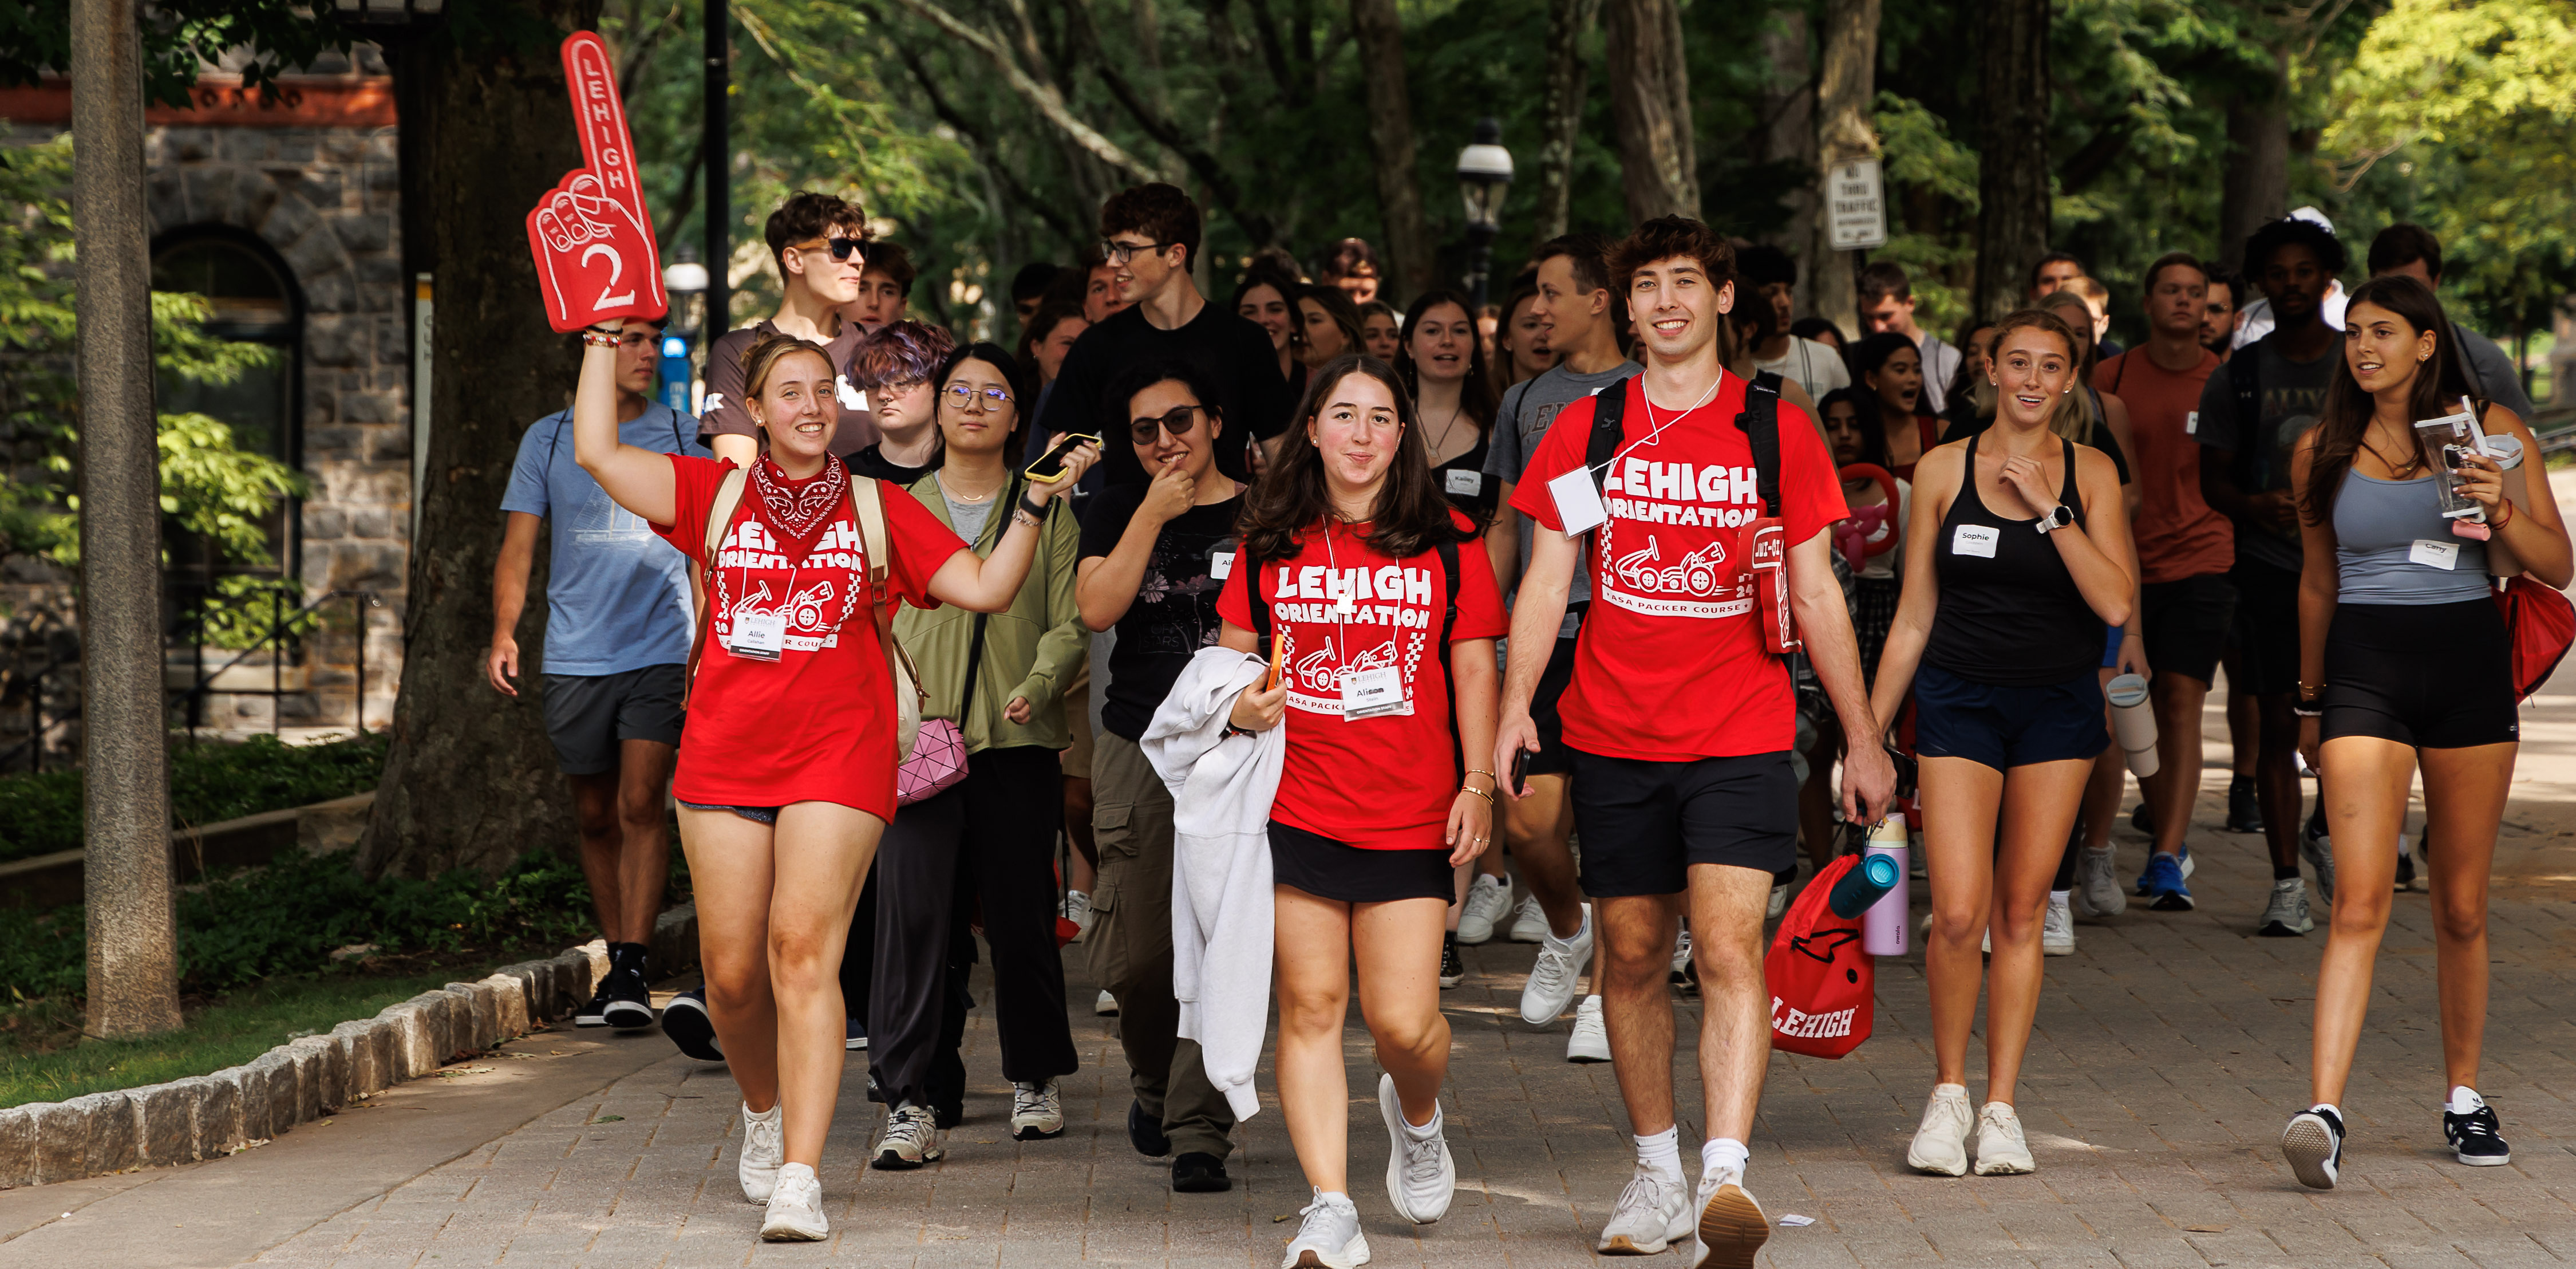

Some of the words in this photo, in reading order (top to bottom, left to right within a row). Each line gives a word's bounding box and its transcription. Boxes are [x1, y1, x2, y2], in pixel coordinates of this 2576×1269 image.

[583, 58, 626, 190] LEHIGH
[581, 243, 635, 312] 2
[1603, 456, 1758, 505] LEHIGH
[1602, 496, 1757, 529] ORIENTATION
[1962, 533, 1989, 541] Sophie
[1274, 566, 1431, 605] LEHIGH
[1601, 571, 1614, 588] 20
[1736, 584, 1755, 598] 24
[1274, 602, 1429, 629] ORIENTATION
[1611, 595, 1633, 606] ASA
[1638, 602, 1687, 612] PACKER
[1693, 604, 1741, 613] COURSE
[748, 630, 765, 639] Allie
[750, 617, 775, 625] LEHIGH
[1358, 672, 1386, 681] LEHIGH
[1289, 696, 1307, 706] ASA
[1311, 702, 1344, 710] PACK
[1357, 688, 1384, 697] Alison
[1772, 996, 1855, 1038] LEHIGH
